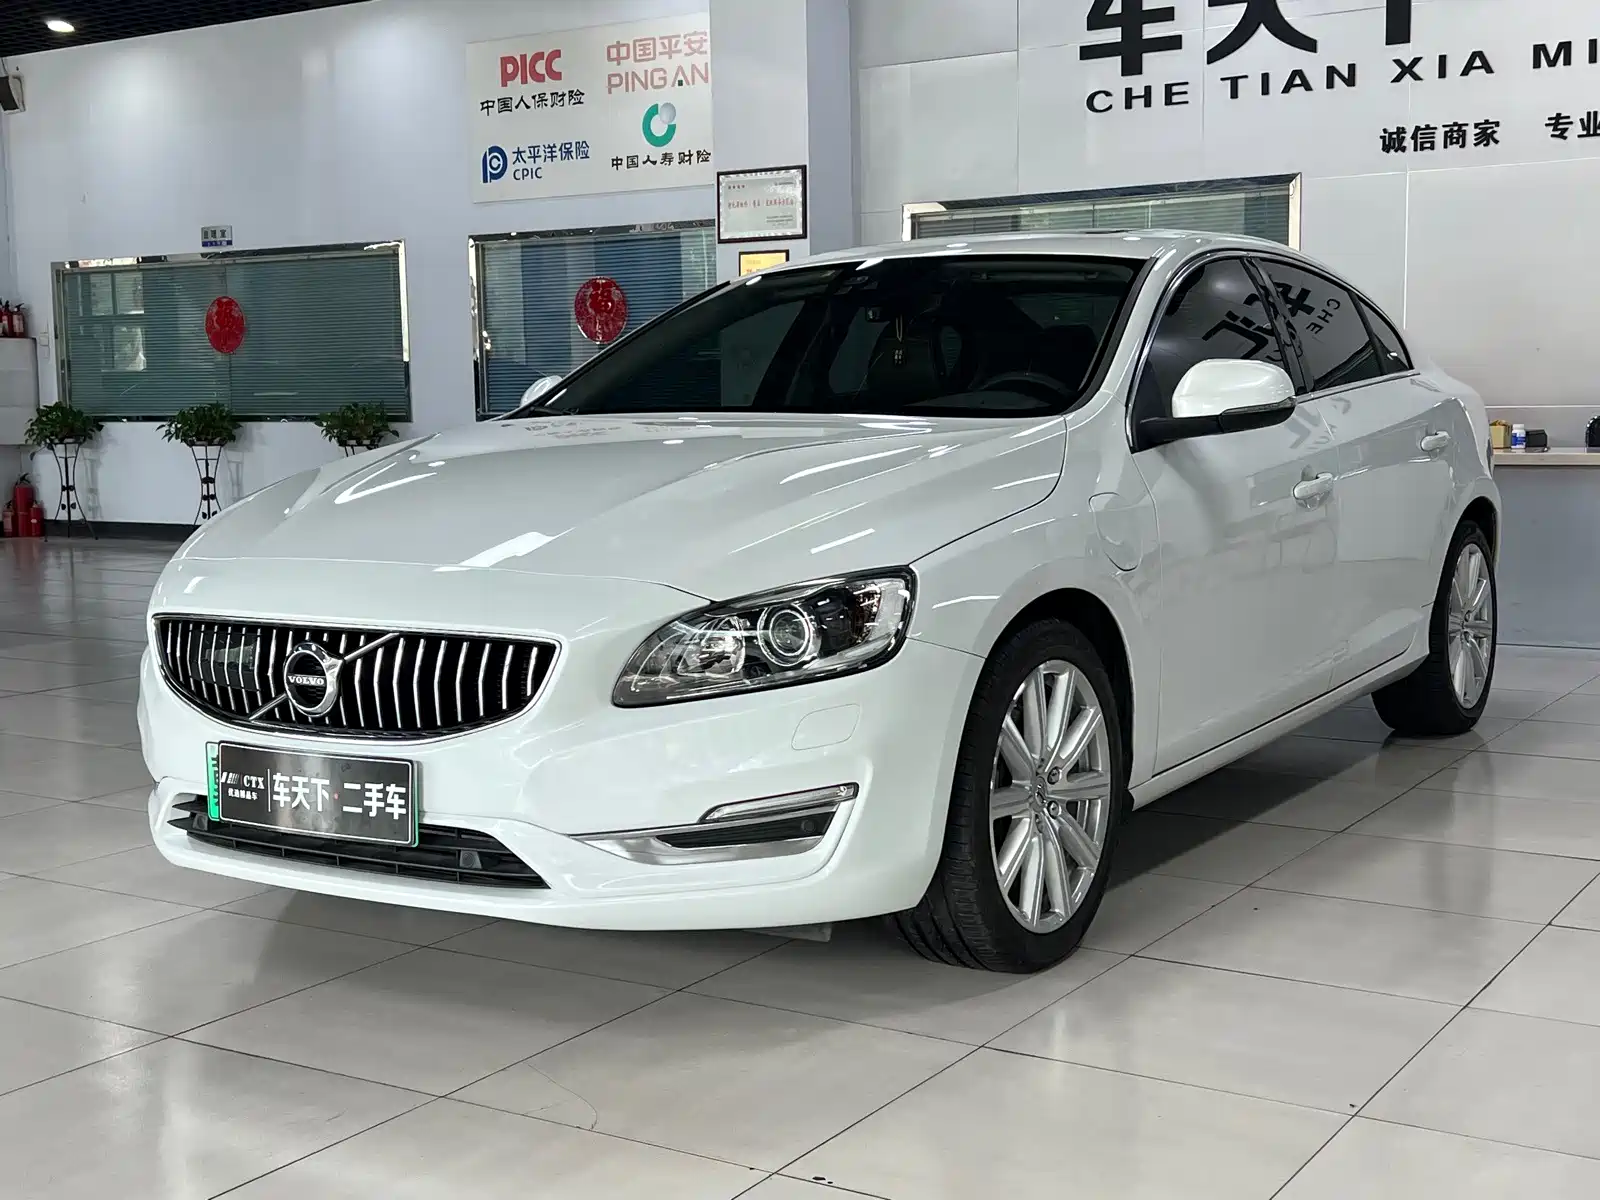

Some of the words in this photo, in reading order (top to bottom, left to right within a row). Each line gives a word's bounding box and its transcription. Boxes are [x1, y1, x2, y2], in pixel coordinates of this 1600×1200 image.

[606, 30, 708, 67] 中国平安
[500, 49, 562, 88] PICC
[1086, 81, 1190, 114] CHE
[1220, 62, 1357, 100] TIAN
[1390, 50, 1495, 84] XIA
[480, 88, 586, 117] 中国人保财险
[1379, 119, 1501, 154] 诚信商家
[1544, 110, 1600, 141] 专业
[511, 140, 591, 166] 太平洋保险
[610, 148, 712, 172] 中国人寿财险
[512, 166, 543, 181] CPIC
[287, 675, 325, 686] VOLVO
[243, 774, 266, 790] CTX
